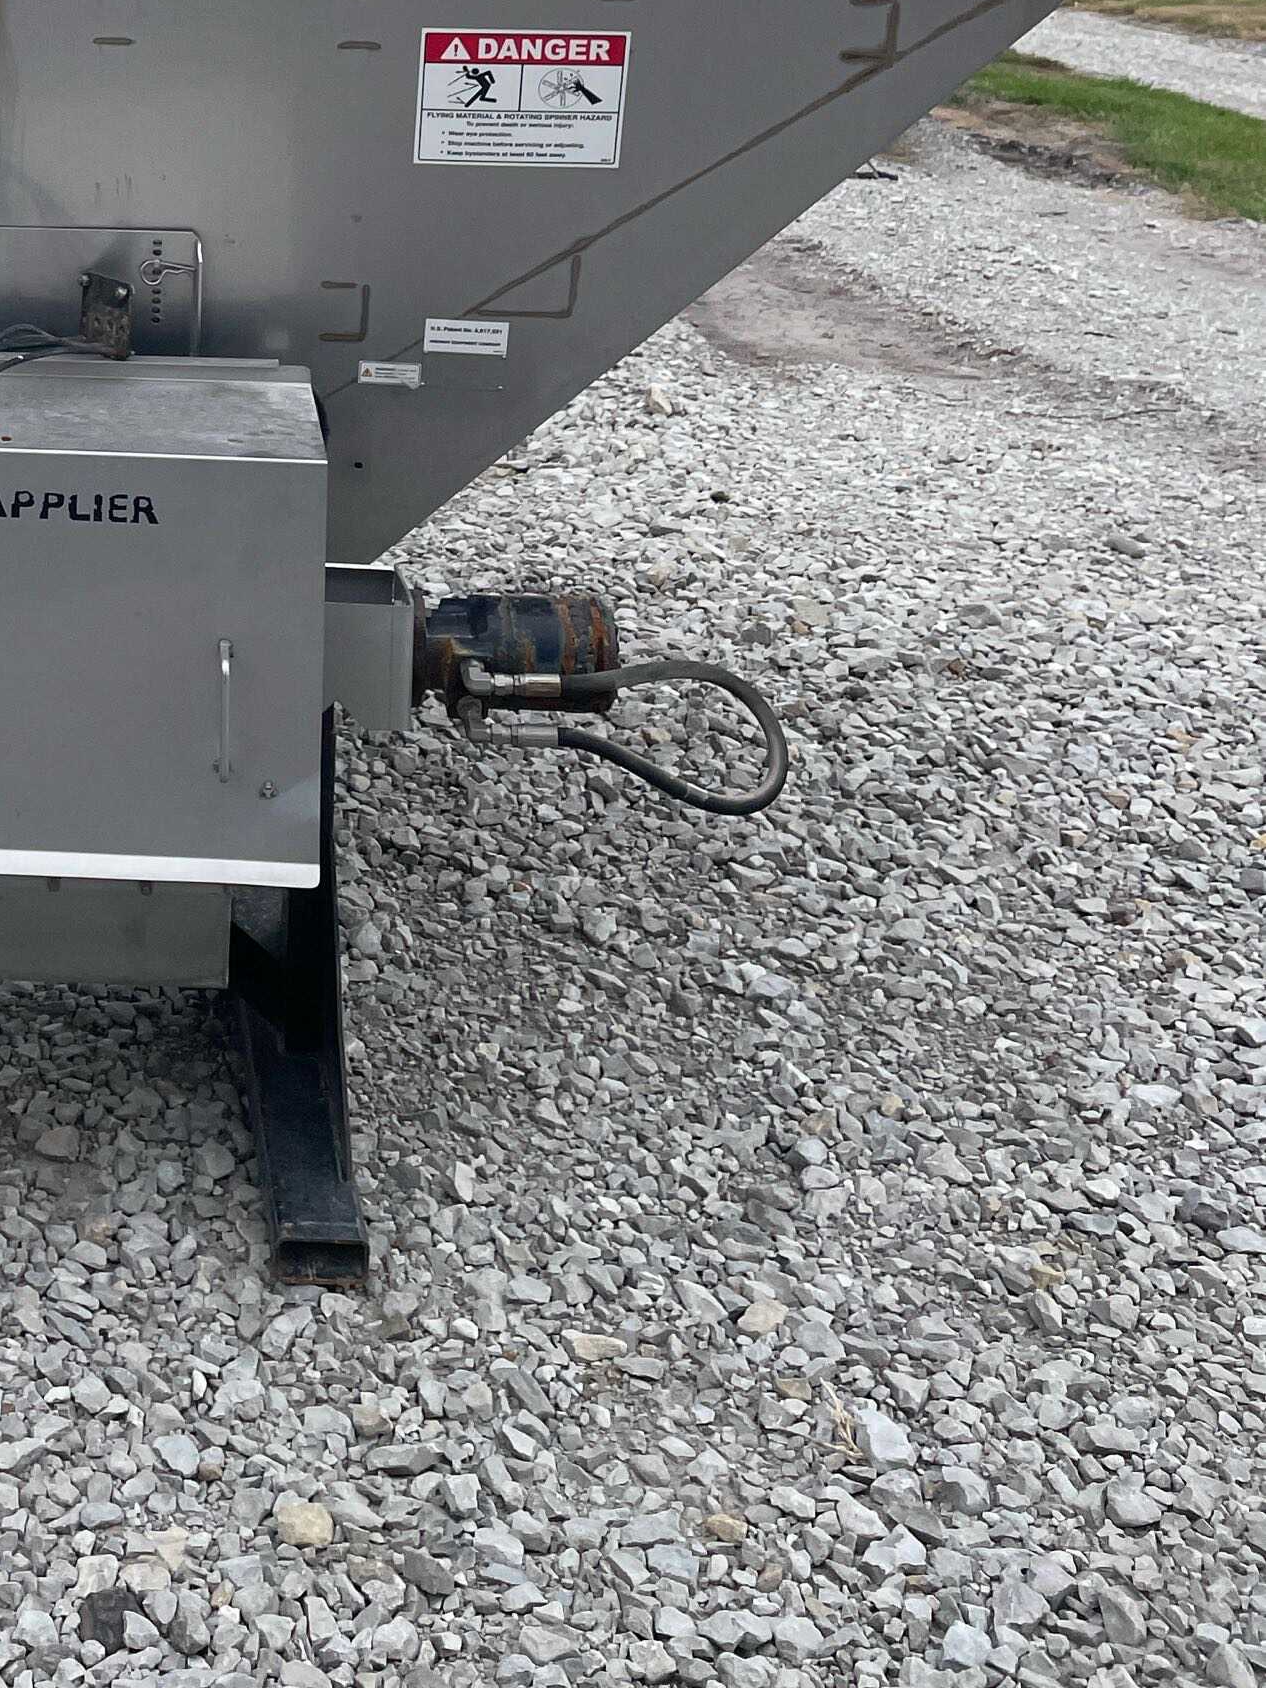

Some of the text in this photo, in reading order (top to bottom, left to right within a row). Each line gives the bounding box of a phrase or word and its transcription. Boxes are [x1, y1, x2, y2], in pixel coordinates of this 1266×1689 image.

[477, 37, 611, 61] DANGER
[456, 112, 495, 120] MATERIAL
[504, 113, 543, 121] ROTATING
